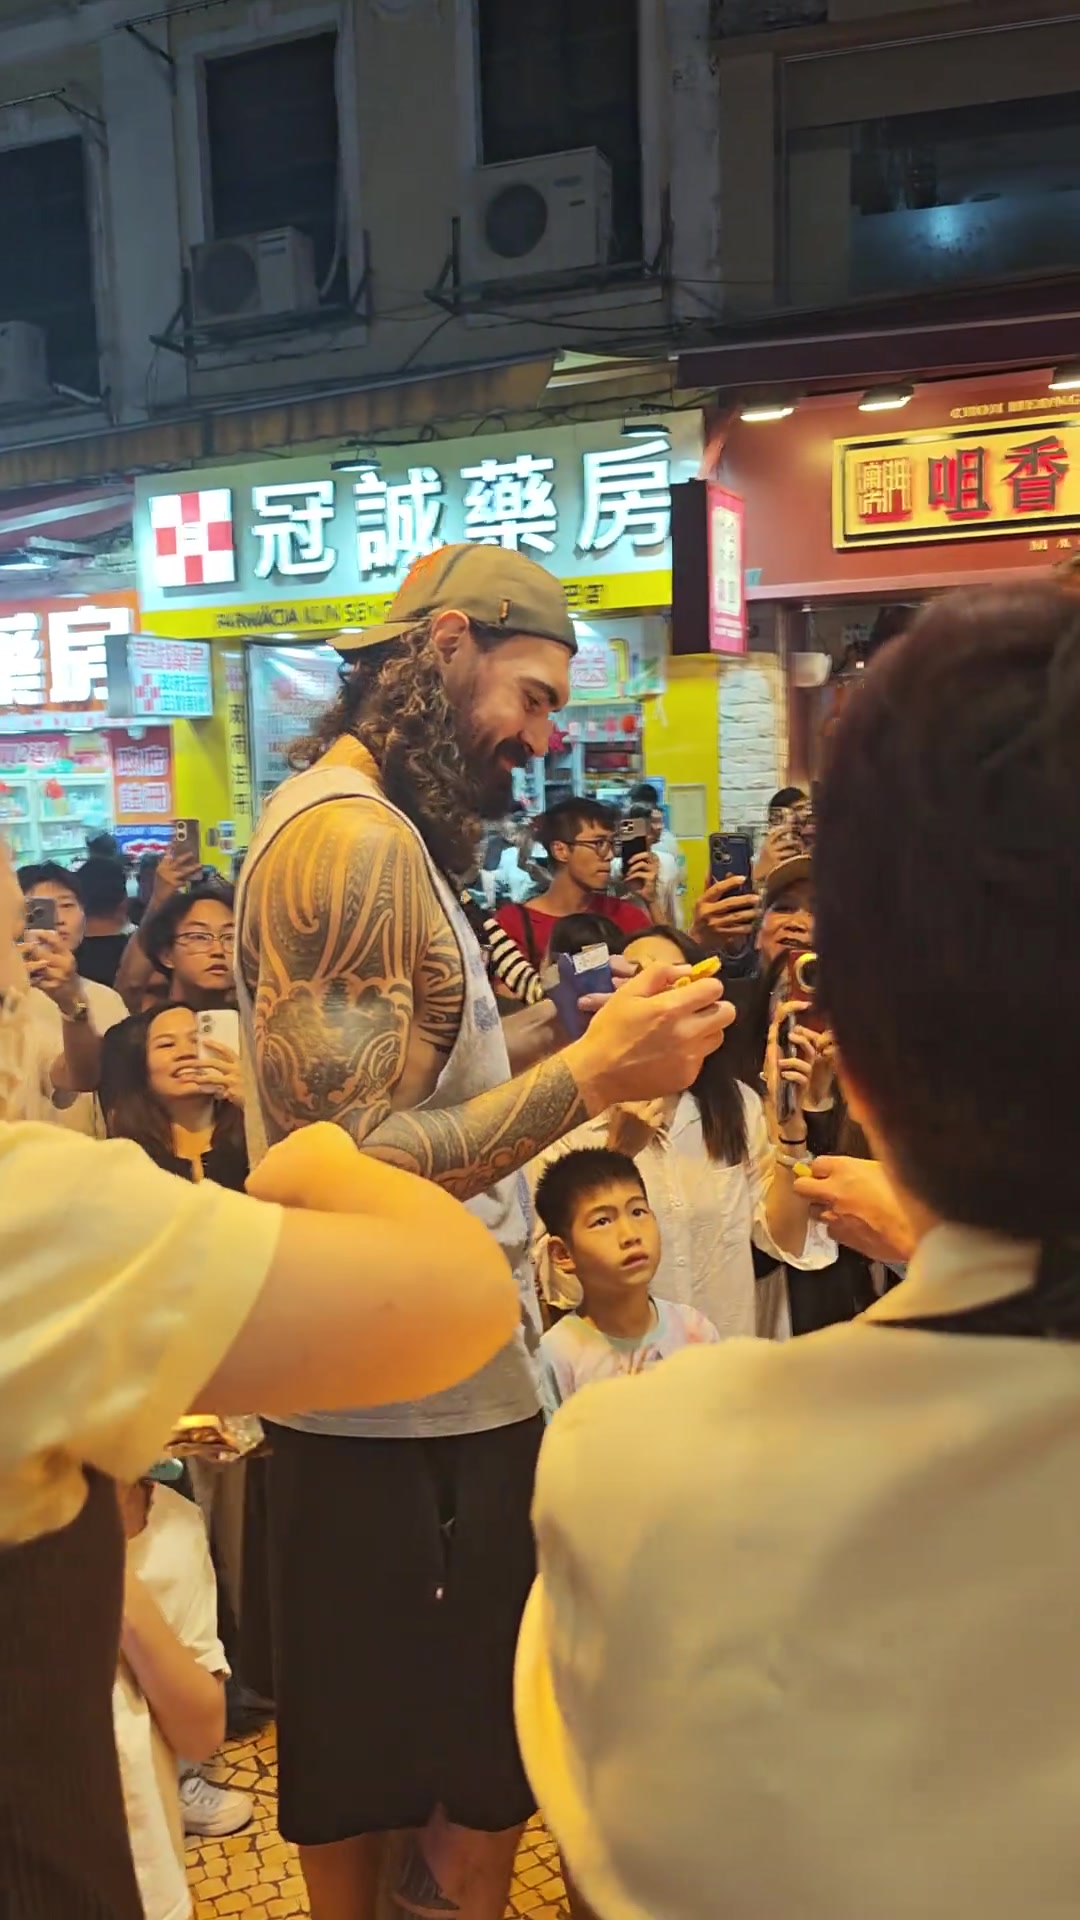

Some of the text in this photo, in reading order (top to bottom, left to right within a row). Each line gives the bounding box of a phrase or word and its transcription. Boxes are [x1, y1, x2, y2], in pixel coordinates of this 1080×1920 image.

[251, 439, 672, 579] 冠誠藥房
[927, 435, 1070, 521] 咀香
